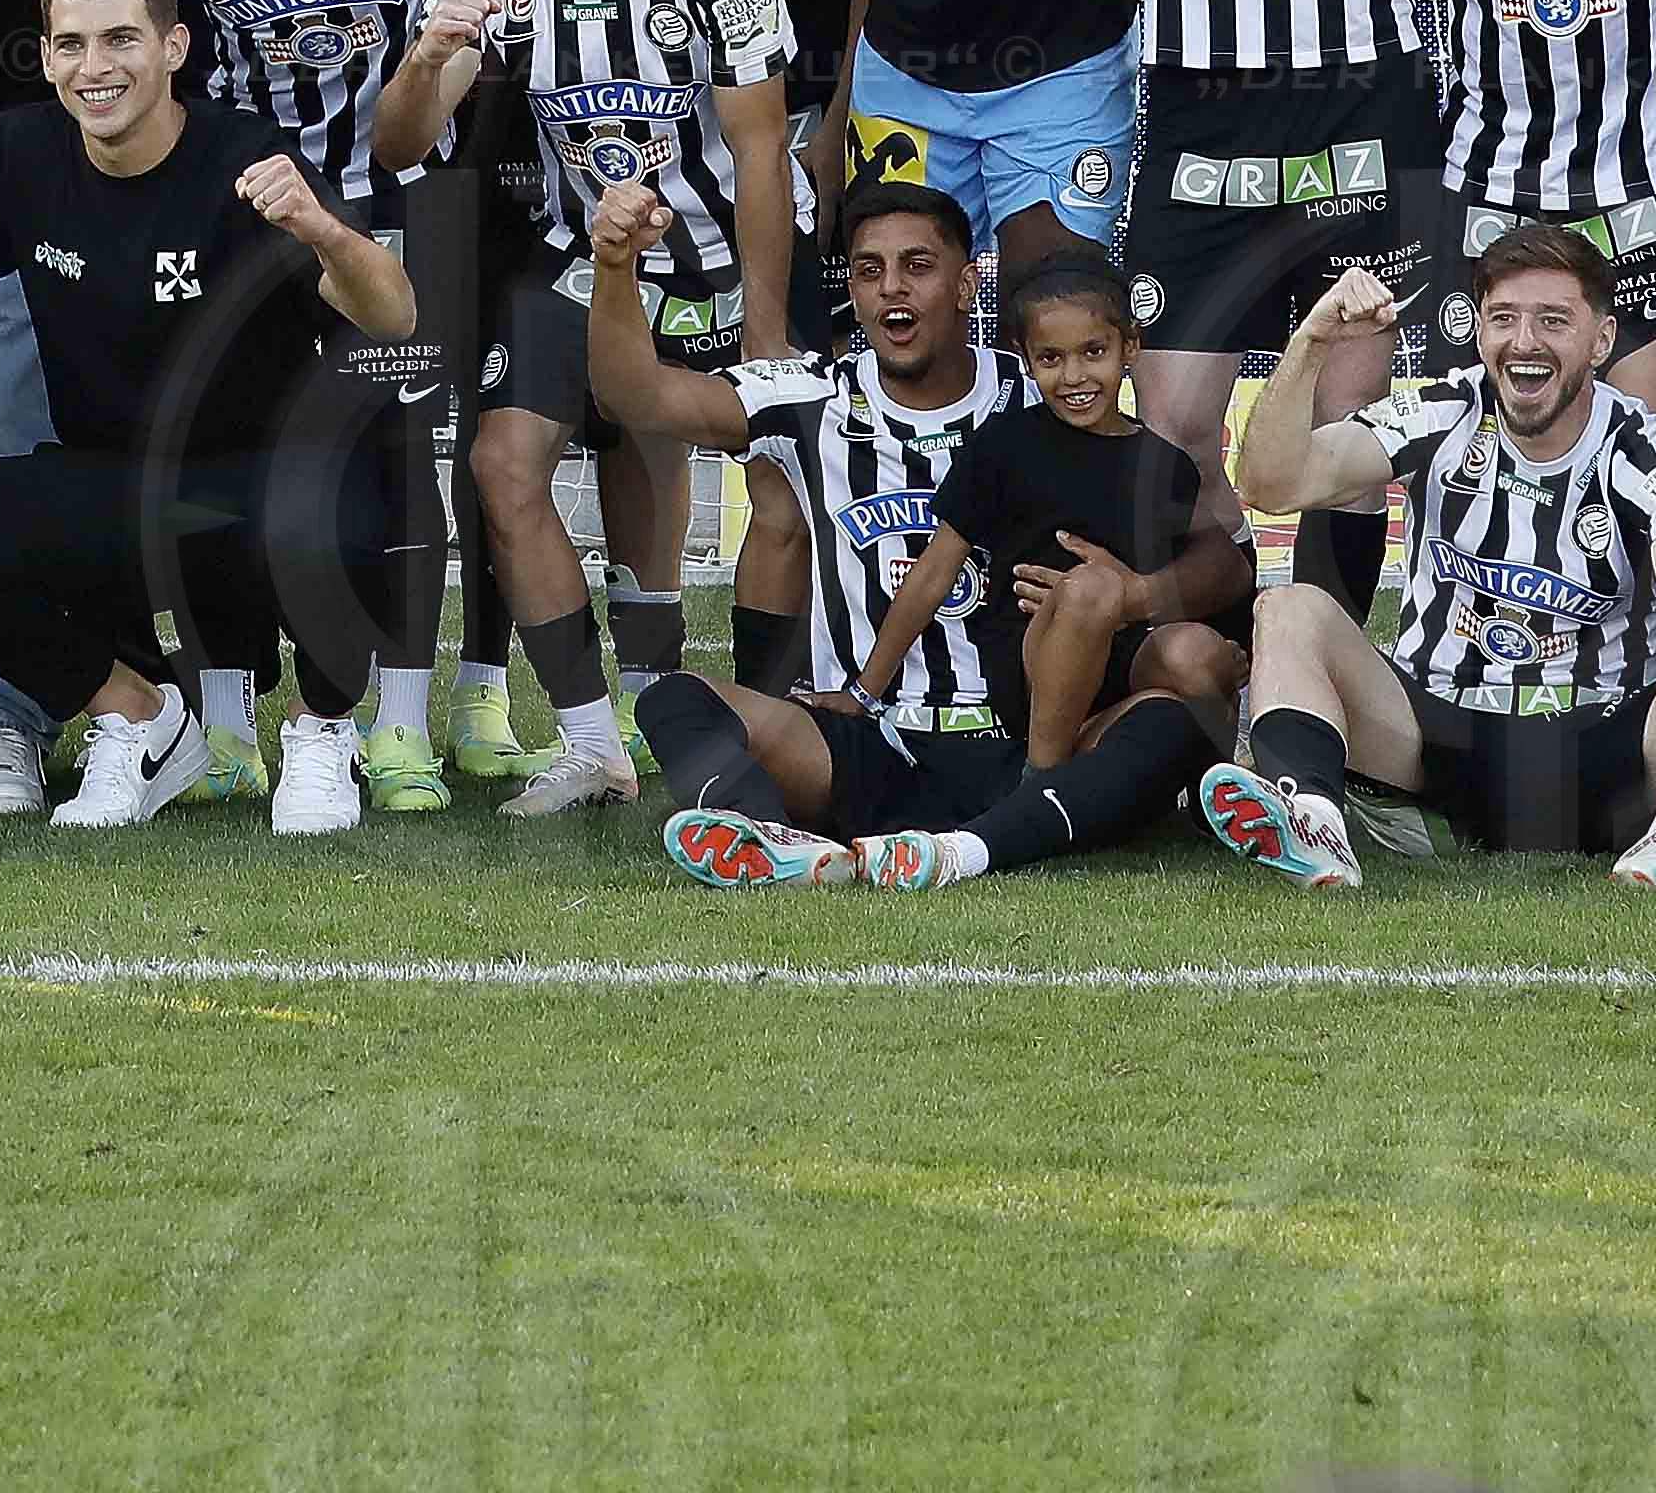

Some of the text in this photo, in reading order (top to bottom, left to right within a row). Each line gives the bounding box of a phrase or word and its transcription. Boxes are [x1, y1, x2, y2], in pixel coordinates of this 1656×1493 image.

[577, 4, 620, 21] GRAWE
[1180, 141, 1385, 207] GRAZ
[1305, 195, 1387, 221] HOLDING
[1329, 240, 1423, 269] DOMAINES
[347, 344, 443, 367] DOMAINES
[356, 360, 431, 375] KILGER
[920, 435, 965, 454] GRAWE
[1511, 479, 1555, 508] GRAWE
[1432, 547, 1615, 624] PUNTIGAMER
